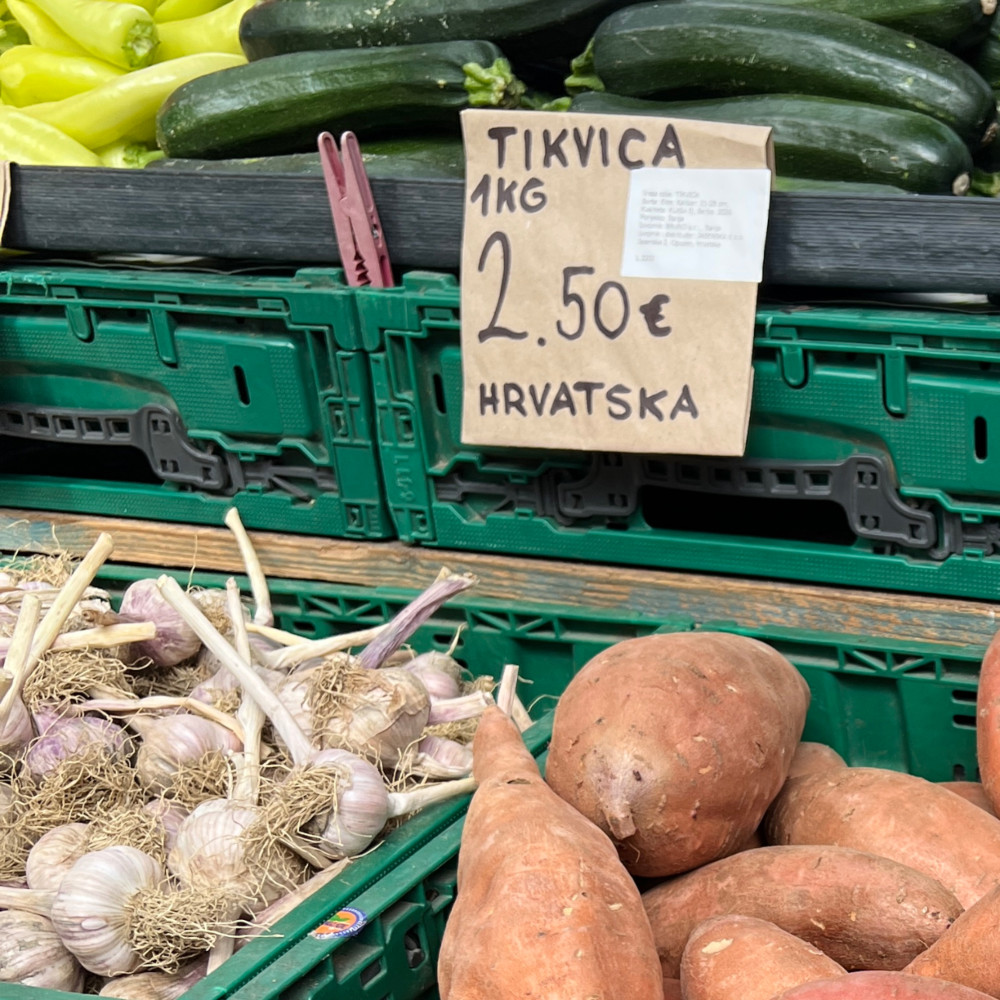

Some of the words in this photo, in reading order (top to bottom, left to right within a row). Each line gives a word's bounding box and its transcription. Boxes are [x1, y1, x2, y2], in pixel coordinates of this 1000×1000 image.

[487, 122, 685, 171] TIKVICA
[470, 173, 547, 217] 1KG
[479, 381, 699, 422] HRVATSKA
